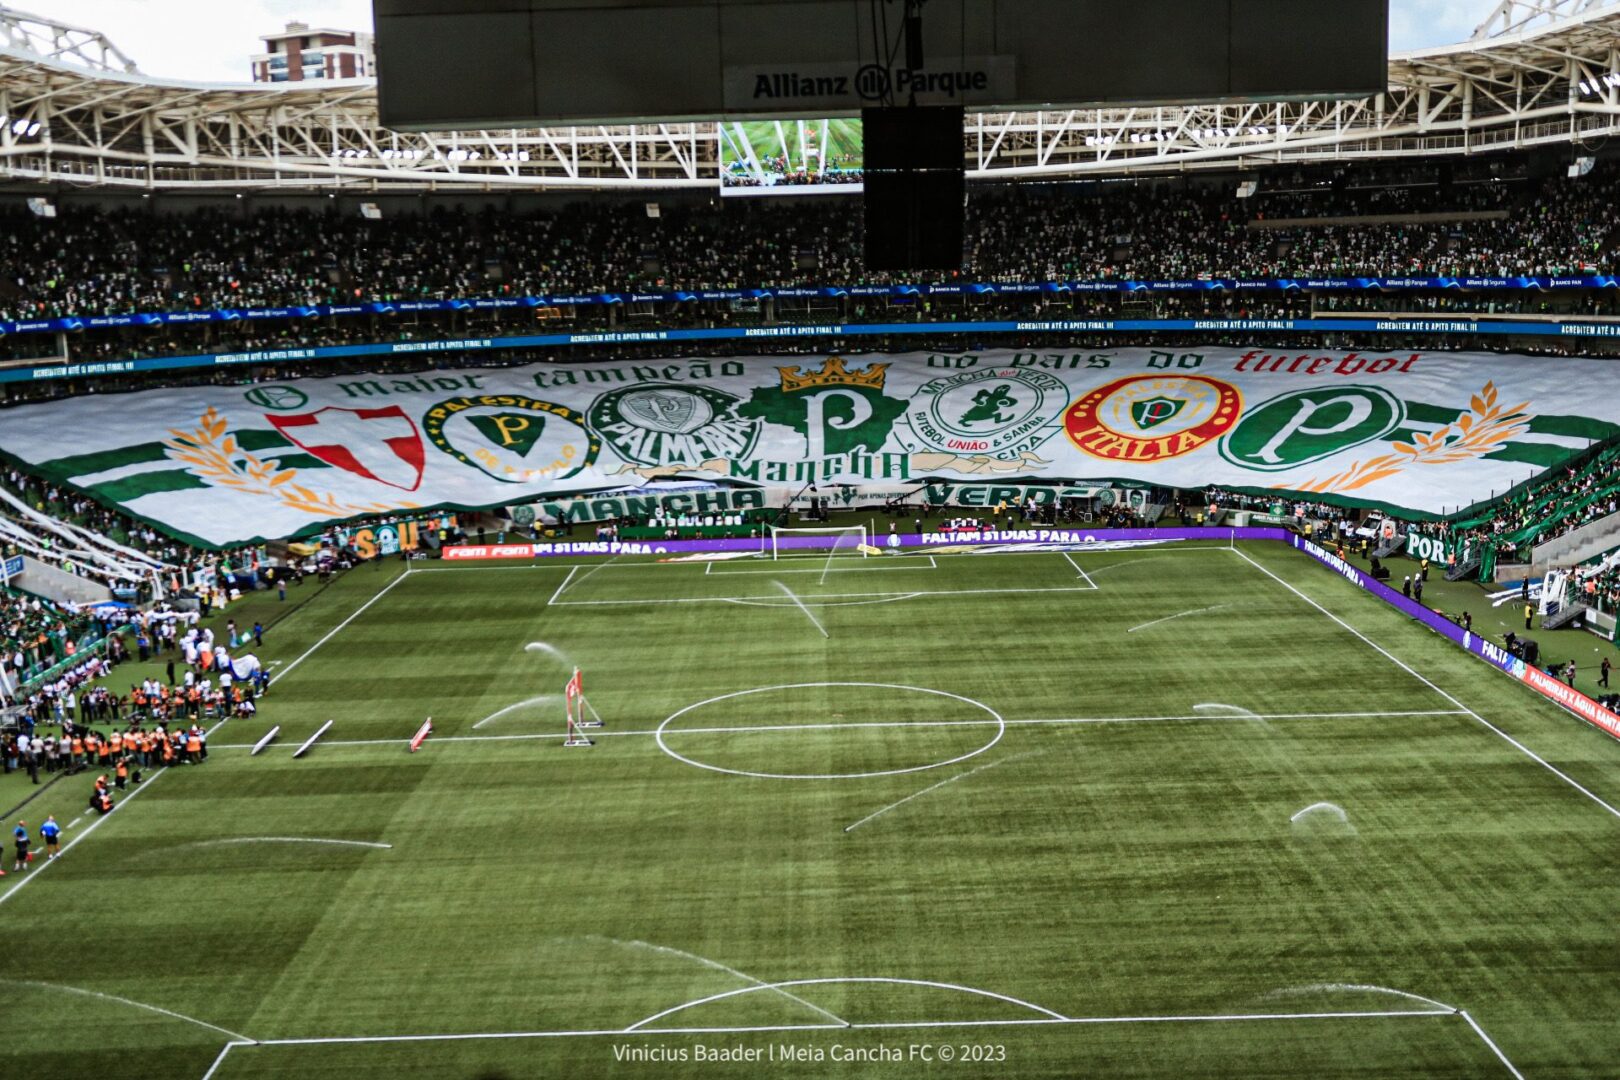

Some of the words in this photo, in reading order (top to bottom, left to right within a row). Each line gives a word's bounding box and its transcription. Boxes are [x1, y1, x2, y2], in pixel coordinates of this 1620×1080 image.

[753, 72, 849, 99] Allianz
[896, 68, 988, 98] Parque
[1051, 320, 1062, 329] ATÉ
[1230, 320, 1241, 328] ATÉ
[1376, 322, 1410, 330] ACREDITEM
[1412, 321, 1423, 330] ATÉ
[1450, 323, 1468, 331] FINAL
[1561, 326, 1595, 335] ACREDITEM
[1597, 325, 1609, 335] ATÉ
[1233, 350, 1425, 376] futebol
[336, 374, 486, 398] maior
[532, 358, 745, 389] campeão
[920, 370, 998, 396] MANCHA
[1016, 370, 1064, 392] VERDE
[428, 396, 571, 419] PALESTRA
[799, 389, 873, 458] P
[948, 438, 988, 451] UNIÃO
[1004, 416, 1047, 442] SAMBA
[1074, 424, 1206, 460] ITALIA
[544, 490, 766, 521] MANCHA
[572, 542, 609, 553] DIAS
[611, 542, 651, 554] PARA
[922, 532, 981, 544] FALTAM
[1001, 530, 1037, 541] DIAS
[1040, 530, 1080, 542] PARA
[1343, 562, 1359, 584] PARA
[1530, 671, 1569, 699] PALMEIRAS
